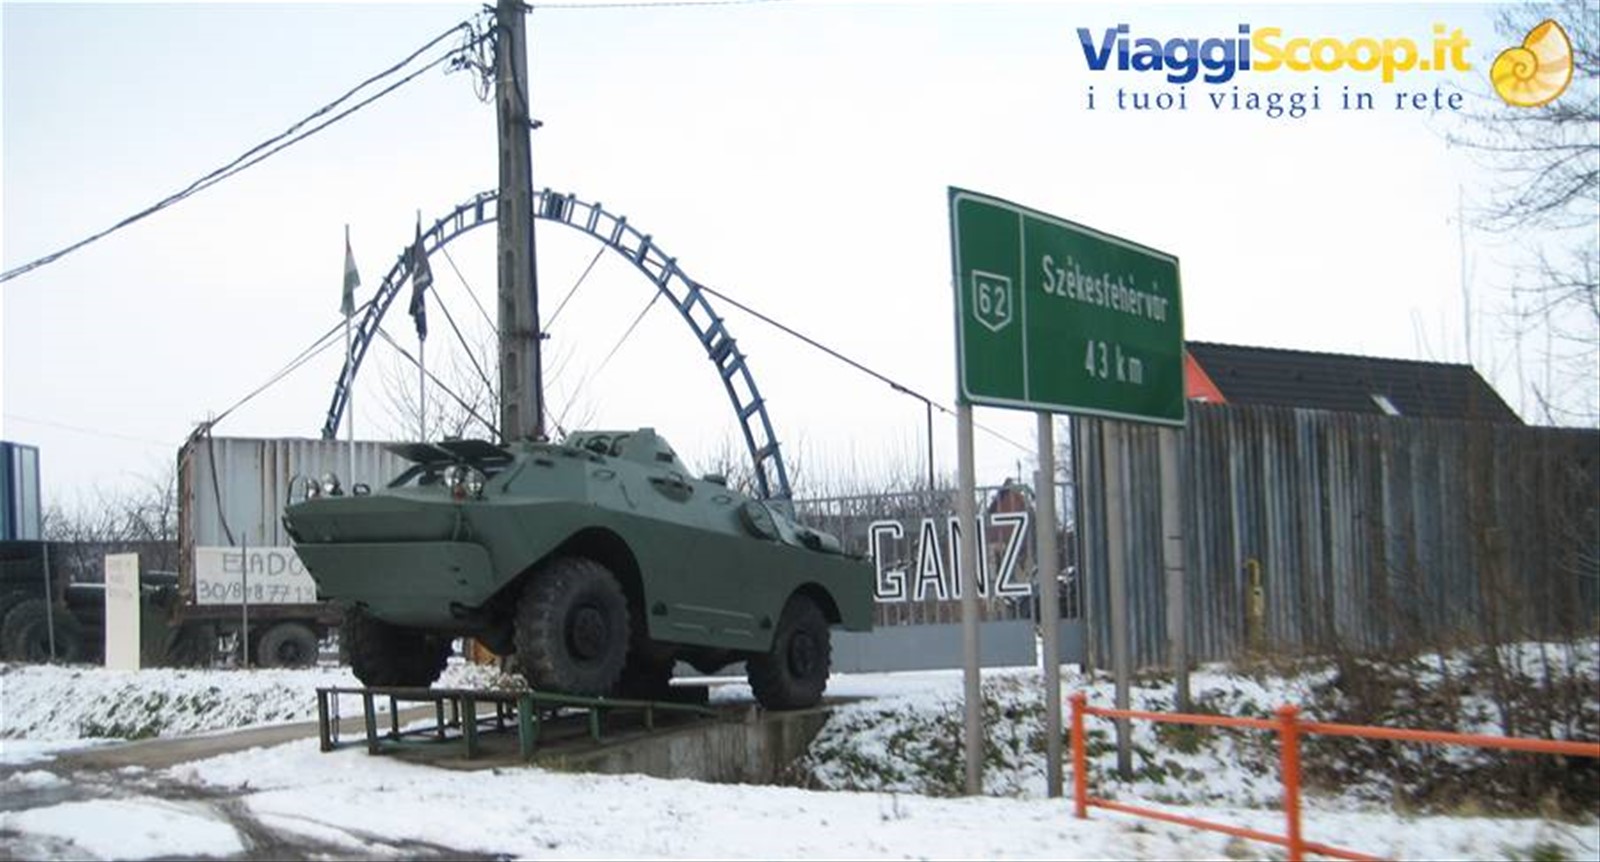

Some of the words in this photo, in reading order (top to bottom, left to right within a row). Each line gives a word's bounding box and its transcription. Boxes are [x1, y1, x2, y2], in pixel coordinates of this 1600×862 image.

[979, 283, 1007, 317] 62
[1042, 254, 1169, 322] Székesfehérvár
[1085, 340, 1109, 379] 43
[1116, 344, 1144, 385] km
[868, 512, 1033, 602] GANZ
